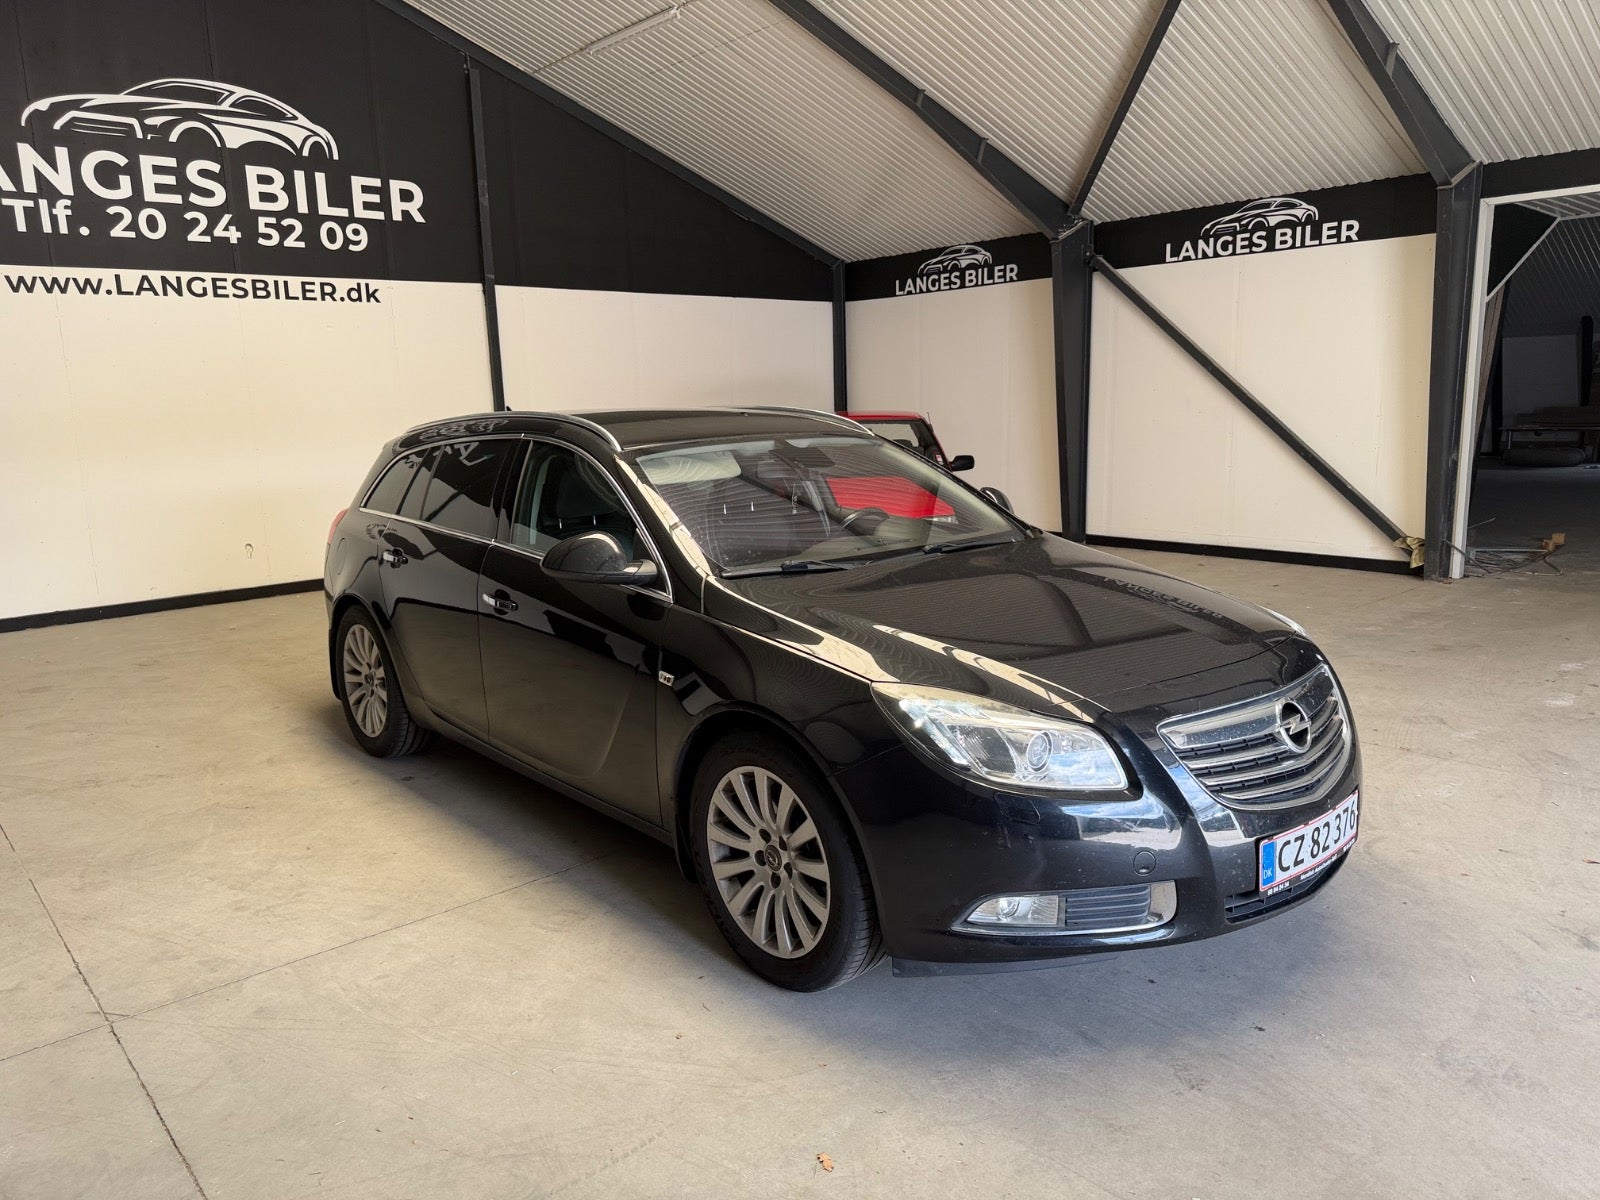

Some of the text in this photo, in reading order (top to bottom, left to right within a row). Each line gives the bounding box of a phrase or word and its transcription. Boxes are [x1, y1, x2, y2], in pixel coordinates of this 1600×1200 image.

[244, 164, 426, 224] BILER
[1, 197, 369, 252] Tlf. 20 24 52 09
[1165, 219, 1360, 263] LANGES BILER
[4, 273, 382, 304] www.LANGESBILER.dk
[895, 263, 1018, 296] LANGES BILER
[1277, 833, 1306, 872] CZ
[1310, 821, 1330, 859] 82
[1333, 801, 1355, 844] 376
[1263, 868, 1272, 879] DK
